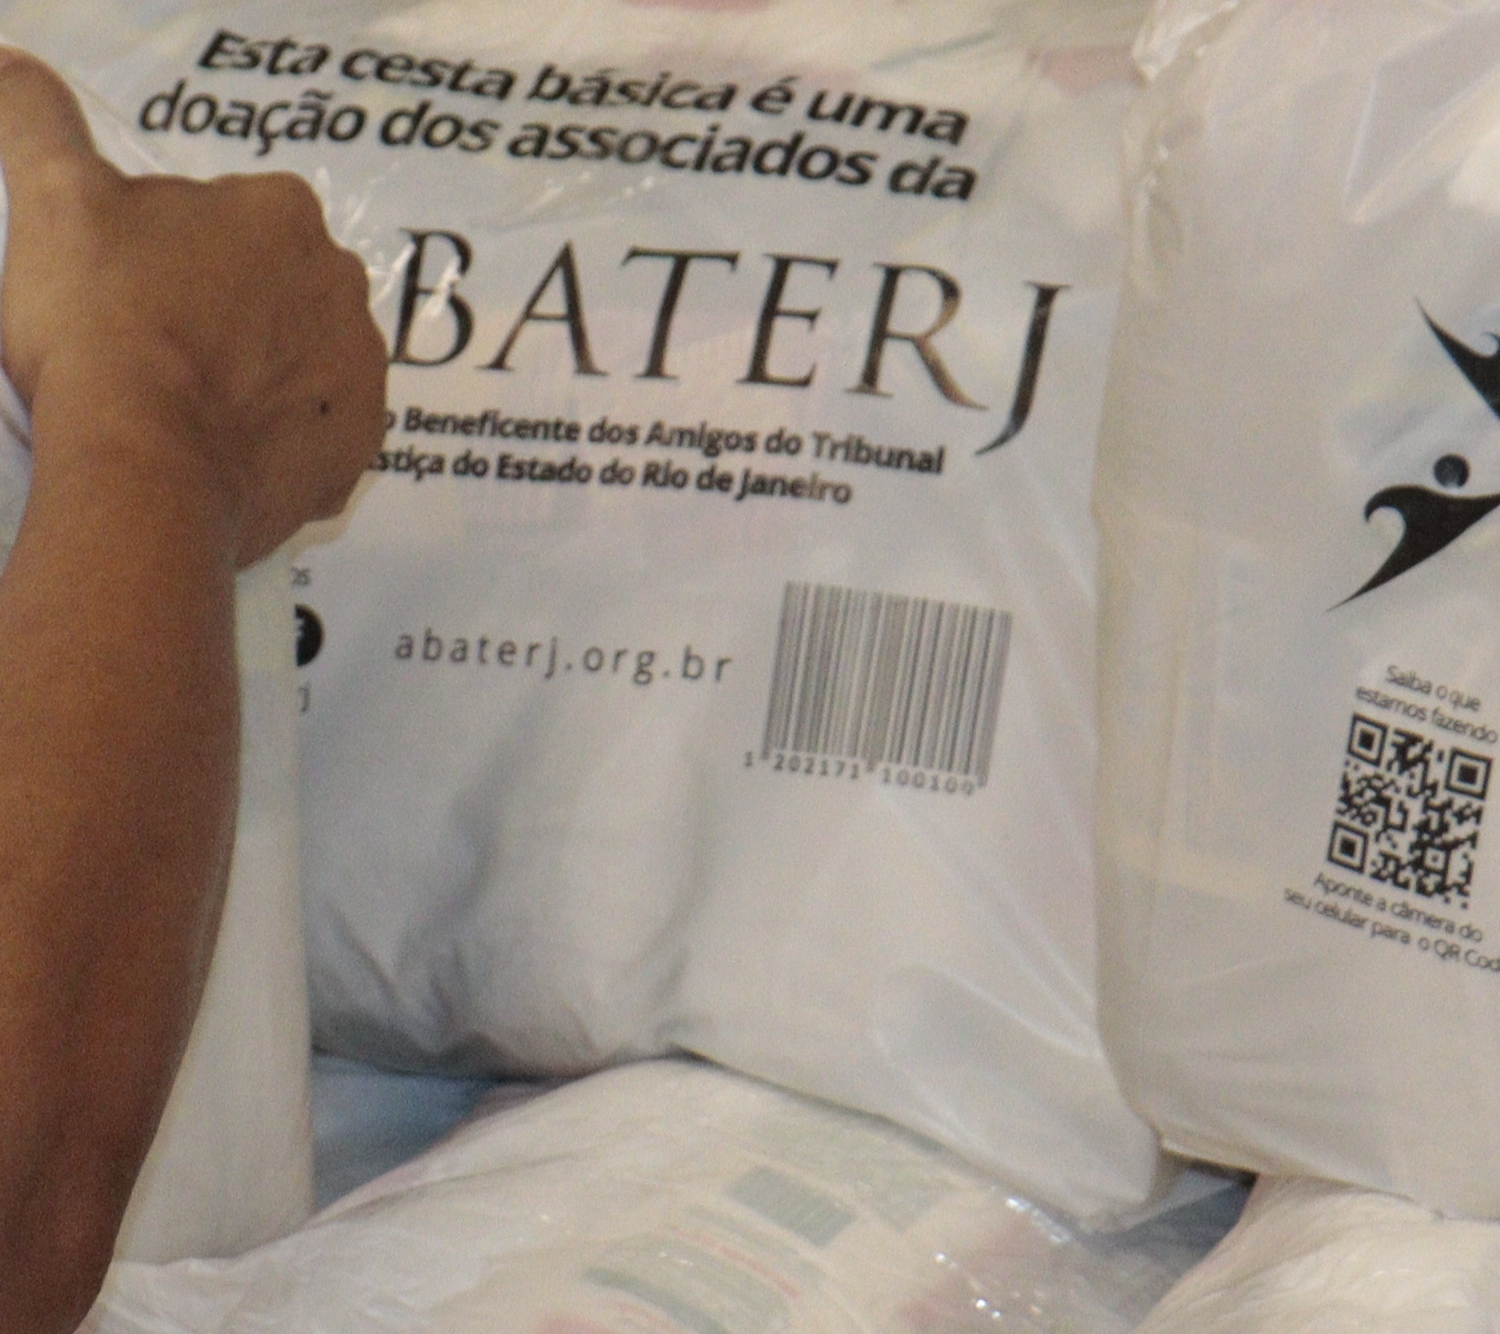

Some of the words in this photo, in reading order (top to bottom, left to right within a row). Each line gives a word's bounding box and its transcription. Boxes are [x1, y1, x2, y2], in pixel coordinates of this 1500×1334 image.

[197, 28, 331, 74] Esta
[341, 48, 515, 101] cesta
[527, 63, 738, 111] básica
[751, 75, 800, 116] é
[805, 89, 970, 145] uma
[139, 79, 368, 156] doação
[380, 99, 502, 152] dos
[507, 122, 879, 186] associados
[887, 156, 978, 201] da
[388, 228, 1074, 458] BATERJ
[404, 406, 581, 442] Beneficente
[588, 417, 639, 446] dos
[645, 421, 758, 458] Amigos
[765, 427, 803, 455] do
[813, 431, 945, 474] Tribunal
[372, 445, 445, 482] stiça
[453, 451, 489, 477] do
[497, 453, 593, 484] Estado
[600, 458, 635, 485] do
[643, 459, 689, 489] Rio
[696, 465, 734, 492] de
[735, 467, 853, 504] Janeiro
[394, 628, 732, 686] abaterj.org.br
[1355, 686, 1428, 721] estamos
[1431, 706, 1499, 744] fazendo
[1448, 689, 1481, 712] que
